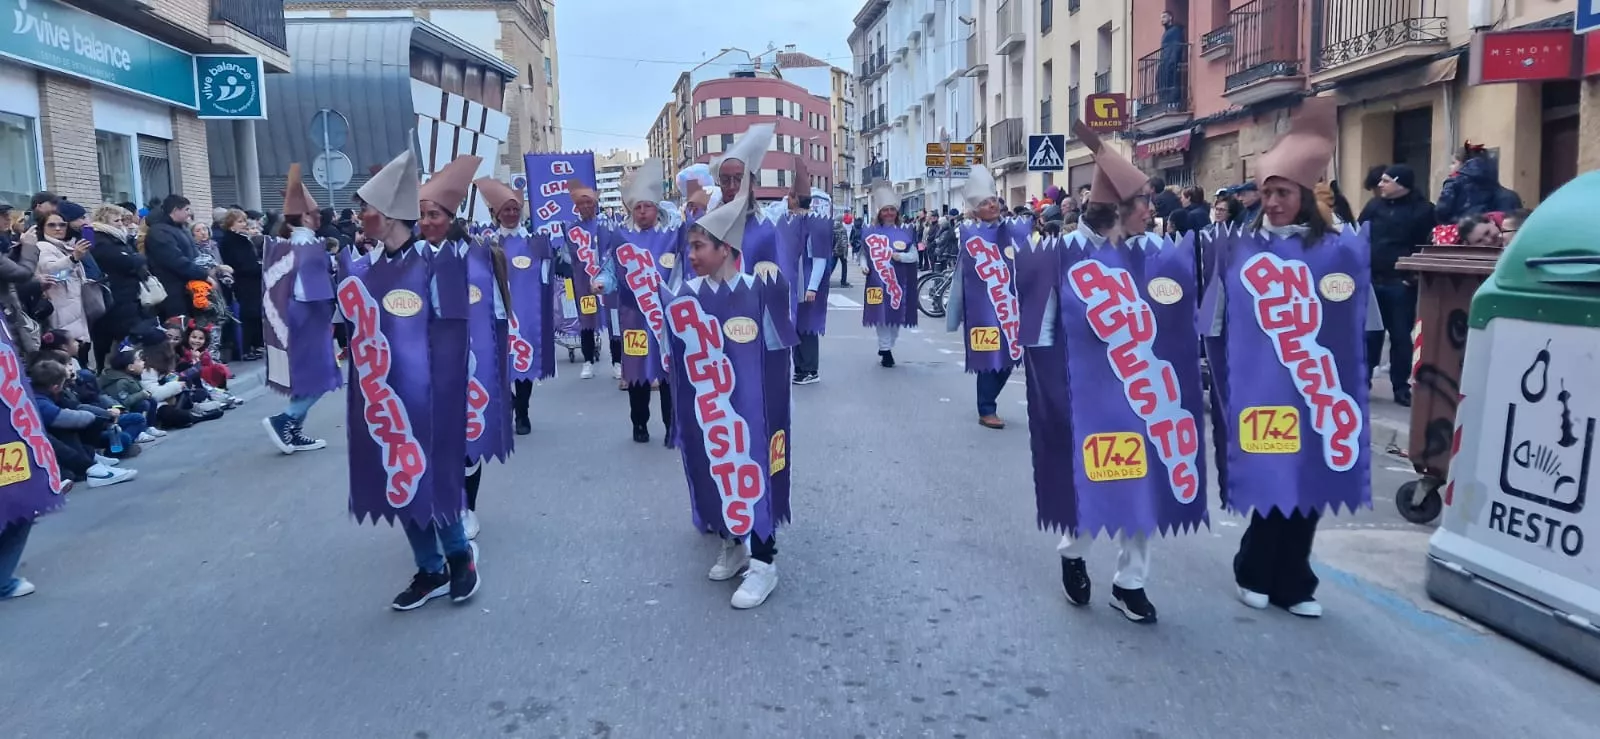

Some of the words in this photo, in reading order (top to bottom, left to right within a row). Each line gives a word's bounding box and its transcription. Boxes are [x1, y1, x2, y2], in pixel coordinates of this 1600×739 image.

[33, 12, 70, 51] vive
[72, 24, 131, 71] balance
[1491, 45, 1563, 56] MEMORY
[202, 76, 213, 99] vive
[208, 61, 251, 79] balance
[554, 163, 572, 173] EL
[539, 201, 559, 219] DE
[1152, 285, 1180, 297] VALOR
[1325, 281, 1354, 294] VALOR
[972, 329, 998, 344] 17+2
[1244, 257, 1357, 466] ANGÜESITOS
[1072, 262, 1197, 499] ANGÜESITOS
[669, 300, 760, 534] ANGÜESITOS
[1243, 410, 1297, 440] 17+2
[1085, 436, 1141, 468] 17+2
[1245, 442, 1297, 450] UNIDADES
[1090, 467, 1143, 479] UNIDADES
[1489, 501, 1583, 556] RESTO
